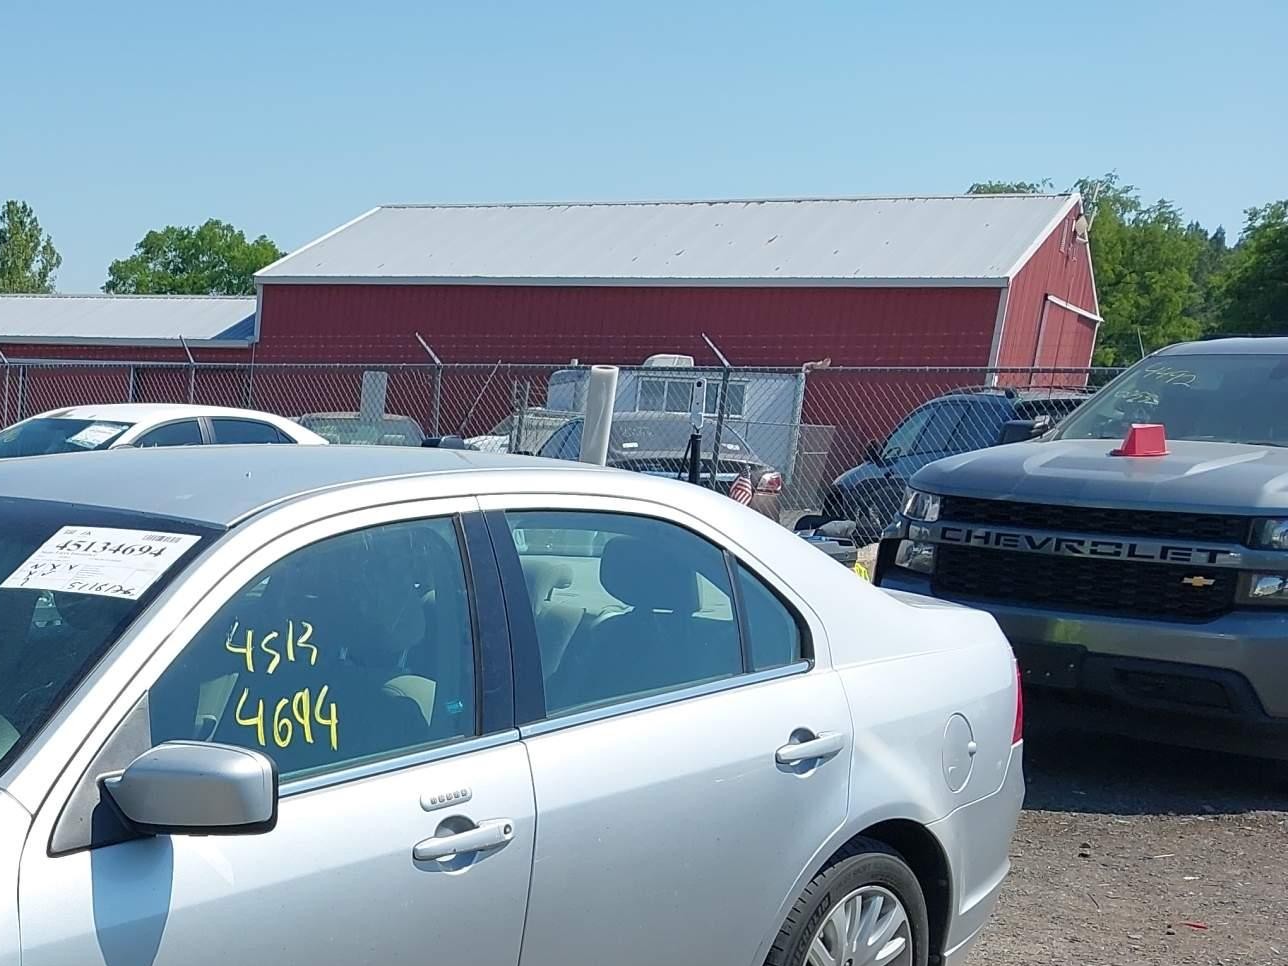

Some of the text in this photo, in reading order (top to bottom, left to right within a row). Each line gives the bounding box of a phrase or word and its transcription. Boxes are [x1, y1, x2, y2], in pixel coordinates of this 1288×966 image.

[55, 538, 168, 559] 45134694
[940, 526, 1235, 564] CHEVROLET
[226, 617, 318, 674] 4513
[235, 685, 339, 751] 4694
